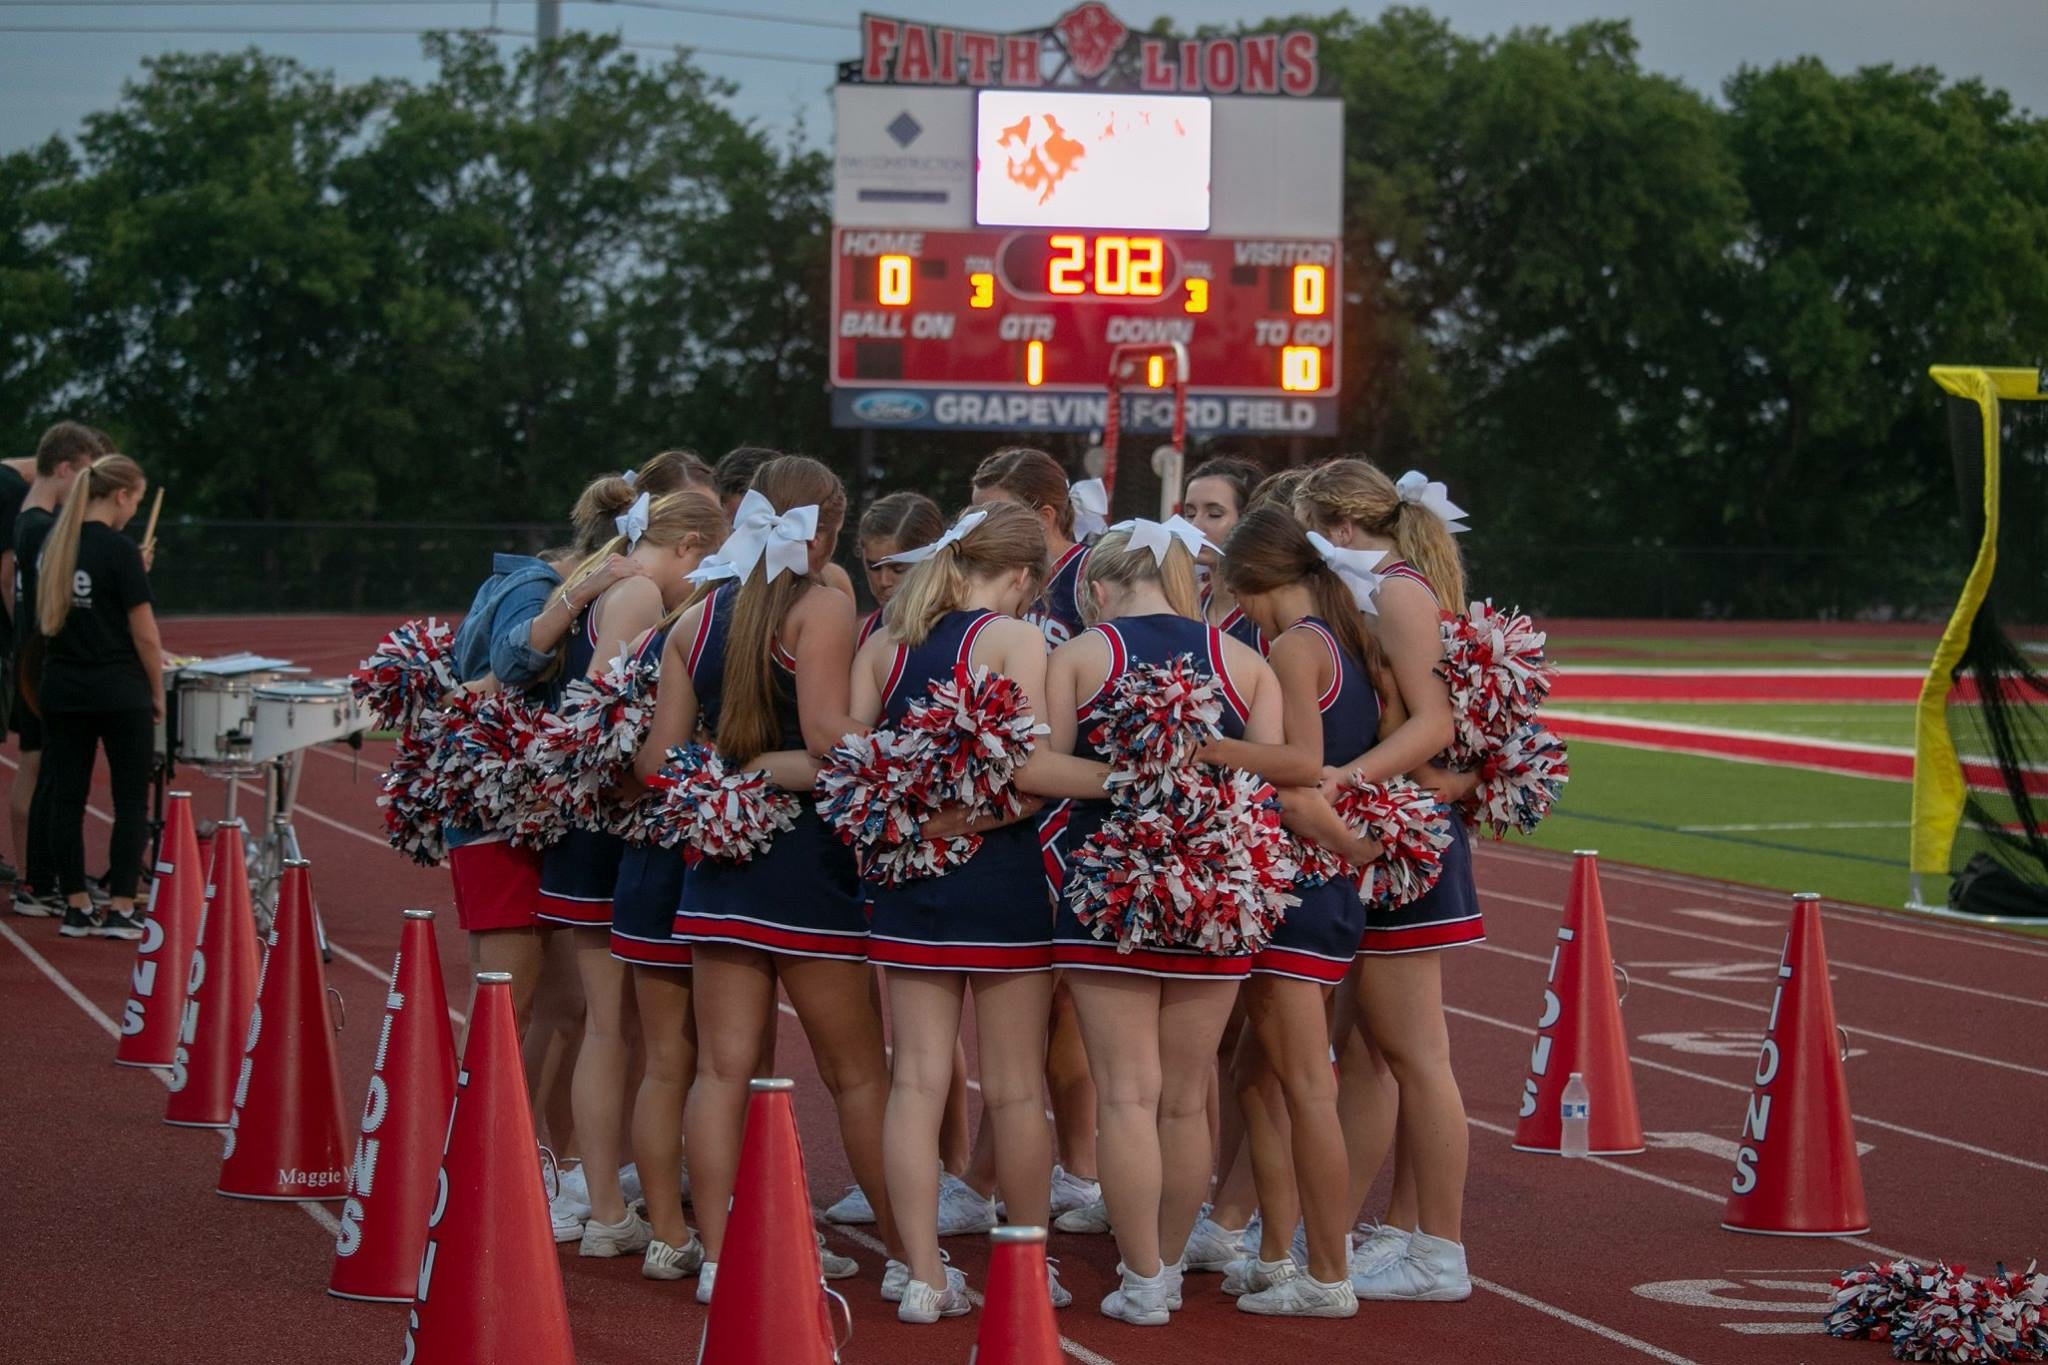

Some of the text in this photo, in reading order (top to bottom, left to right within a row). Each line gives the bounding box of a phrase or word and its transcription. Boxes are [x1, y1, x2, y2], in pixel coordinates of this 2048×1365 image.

[863, 16, 1318, 95] FAITH LIONS
[843, 232, 924, 255] HOME
[1233, 241, 1333, 267] VISITOR
[878, 254, 912, 306] 0
[1050, 235, 1163, 296] 2:02
[969, 273, 994, 309] 3
[1184, 278, 1209, 313] 3
[1293, 265, 1325, 315] 0
[840, 313, 955, 340] BALL ON
[1000, 315, 1056, 342] QTR
[1106, 317, 1195, 345] DOWN
[1255, 320, 1334, 347] TO GO
[1027, 340, 1044, 386] 1
[1148, 354, 1164, 388] 1
[1282, 345, 1321, 391] 10
[933, 393, 1128, 428] GRAPEVIN
[1229, 401, 1318, 430] FIELD
[278, 1167, 341, 1188] Maggie
